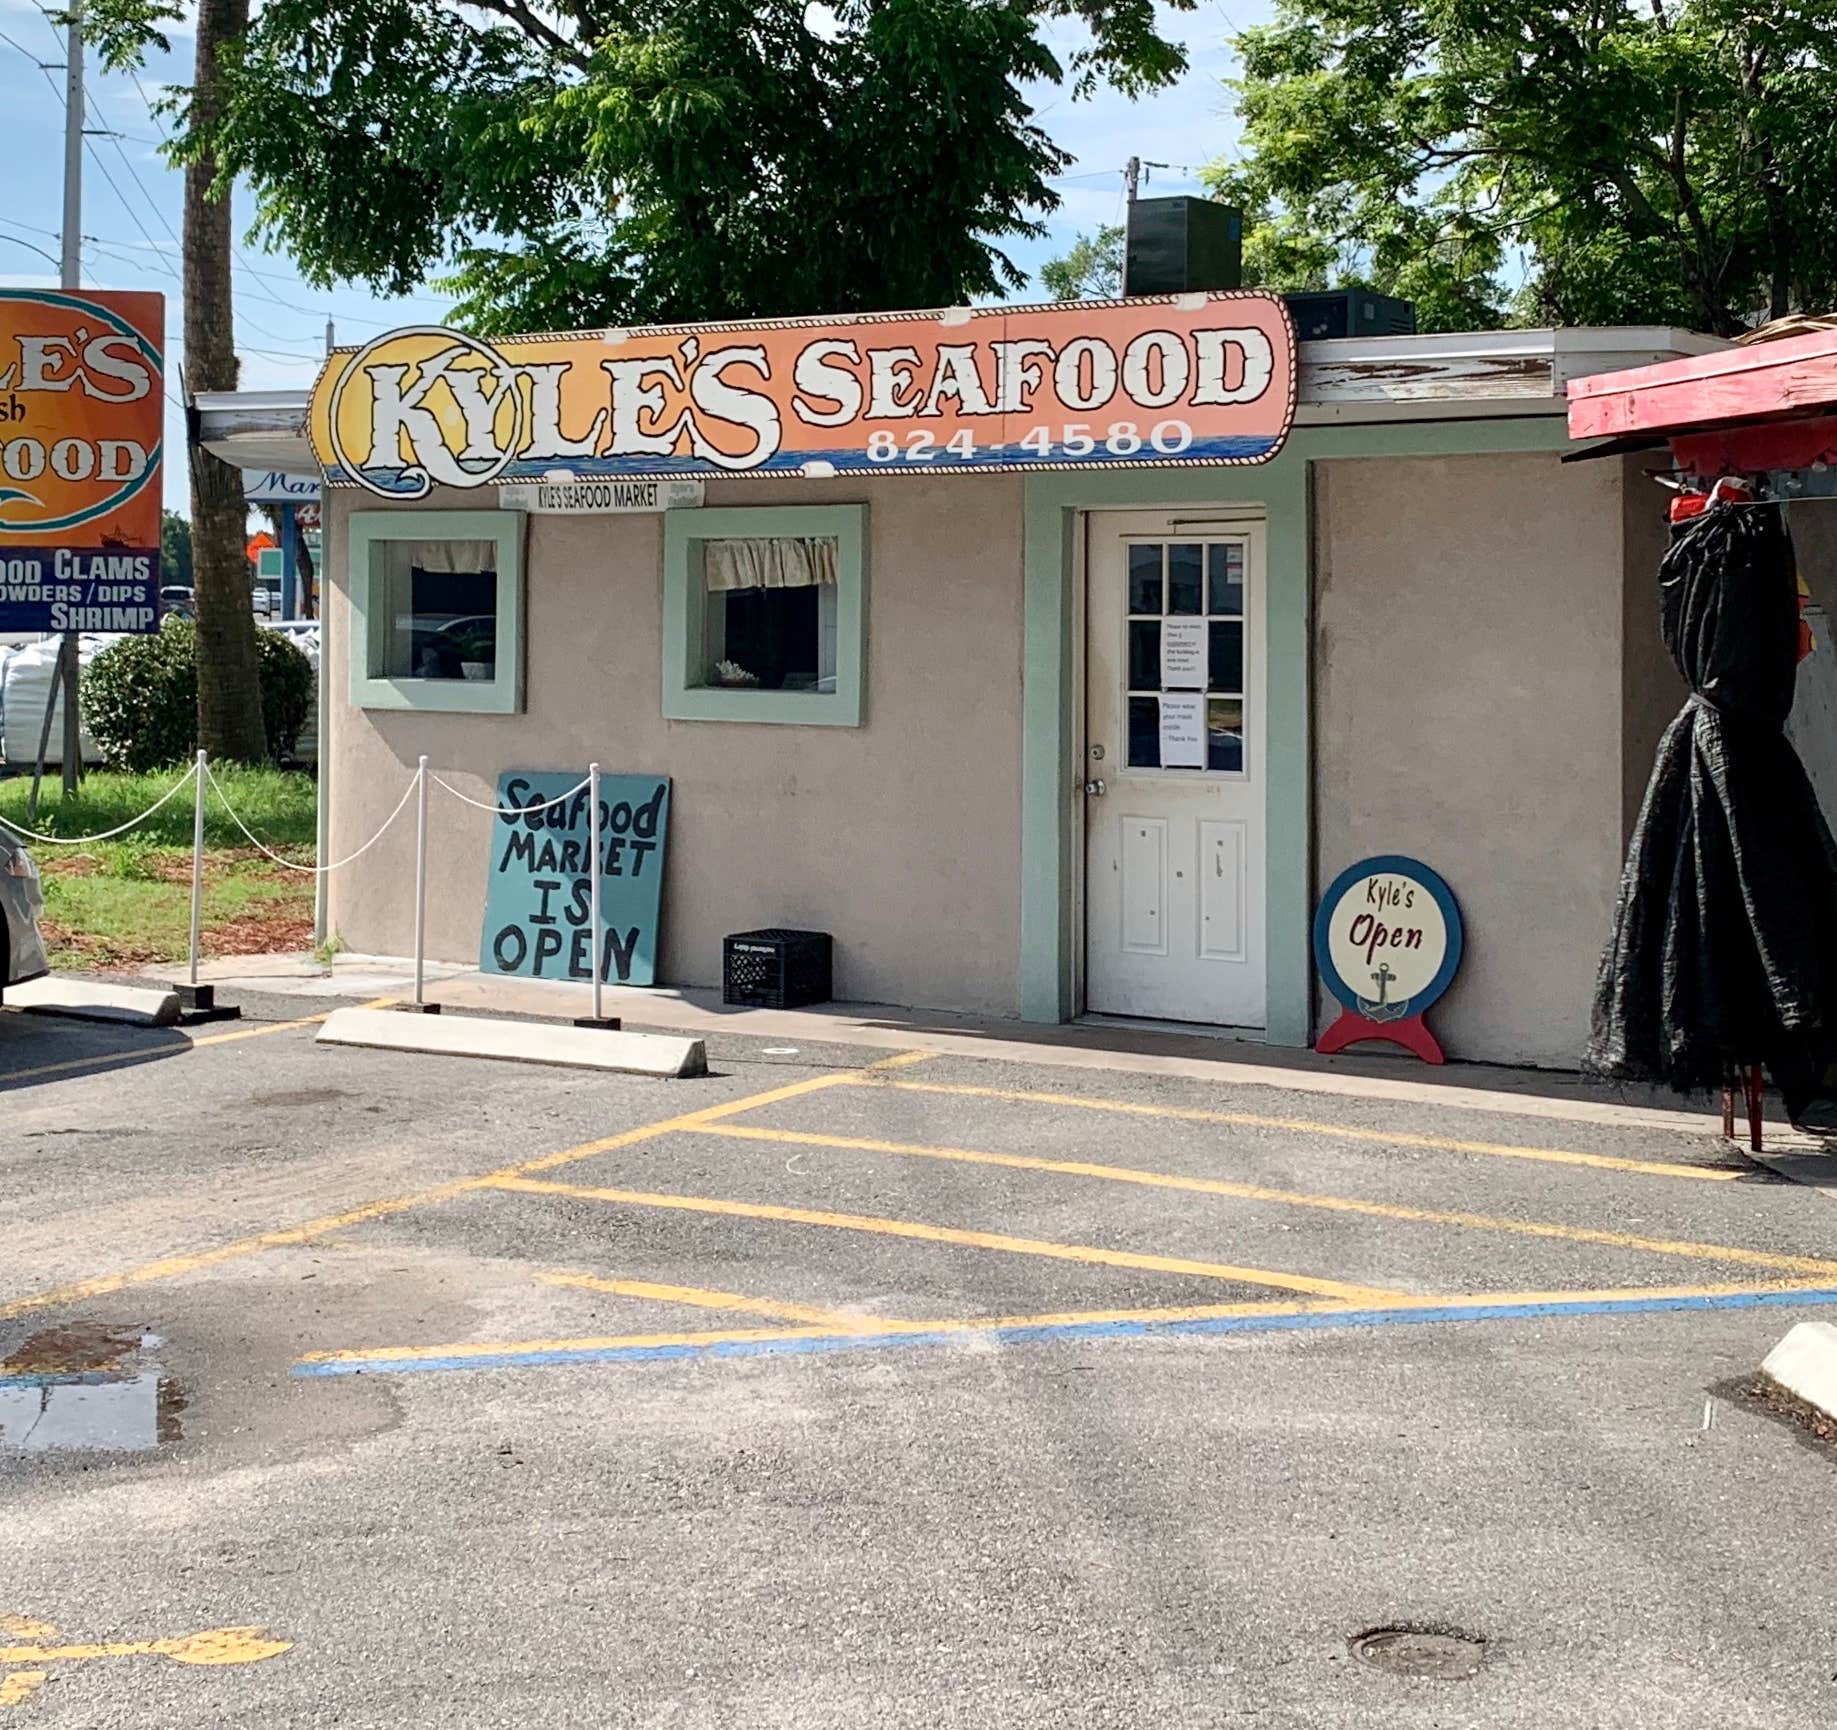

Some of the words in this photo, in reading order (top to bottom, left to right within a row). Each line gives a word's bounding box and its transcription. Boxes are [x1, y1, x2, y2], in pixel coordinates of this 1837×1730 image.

[360, 336, 783, 487] KYLE'S
[791, 326, 1276, 429] SEAFOOD
[866, 420, 1194, 463] 824-4580
[538, 485, 562, 509] KYLE'S
[562, 484, 611, 509] SEAFOOD
[613, 483, 658, 508] MARKET
[54, 548, 150, 581] CLAMS
[50, 602, 154, 630] SHRIMP
[497, 778, 667, 838] Seafood
[528, 878, 594, 927] IS
[1366, 877, 1415, 912] Kyle's
[493, 924, 641, 982] OPEN
[1349, 913, 1423, 965] Open
